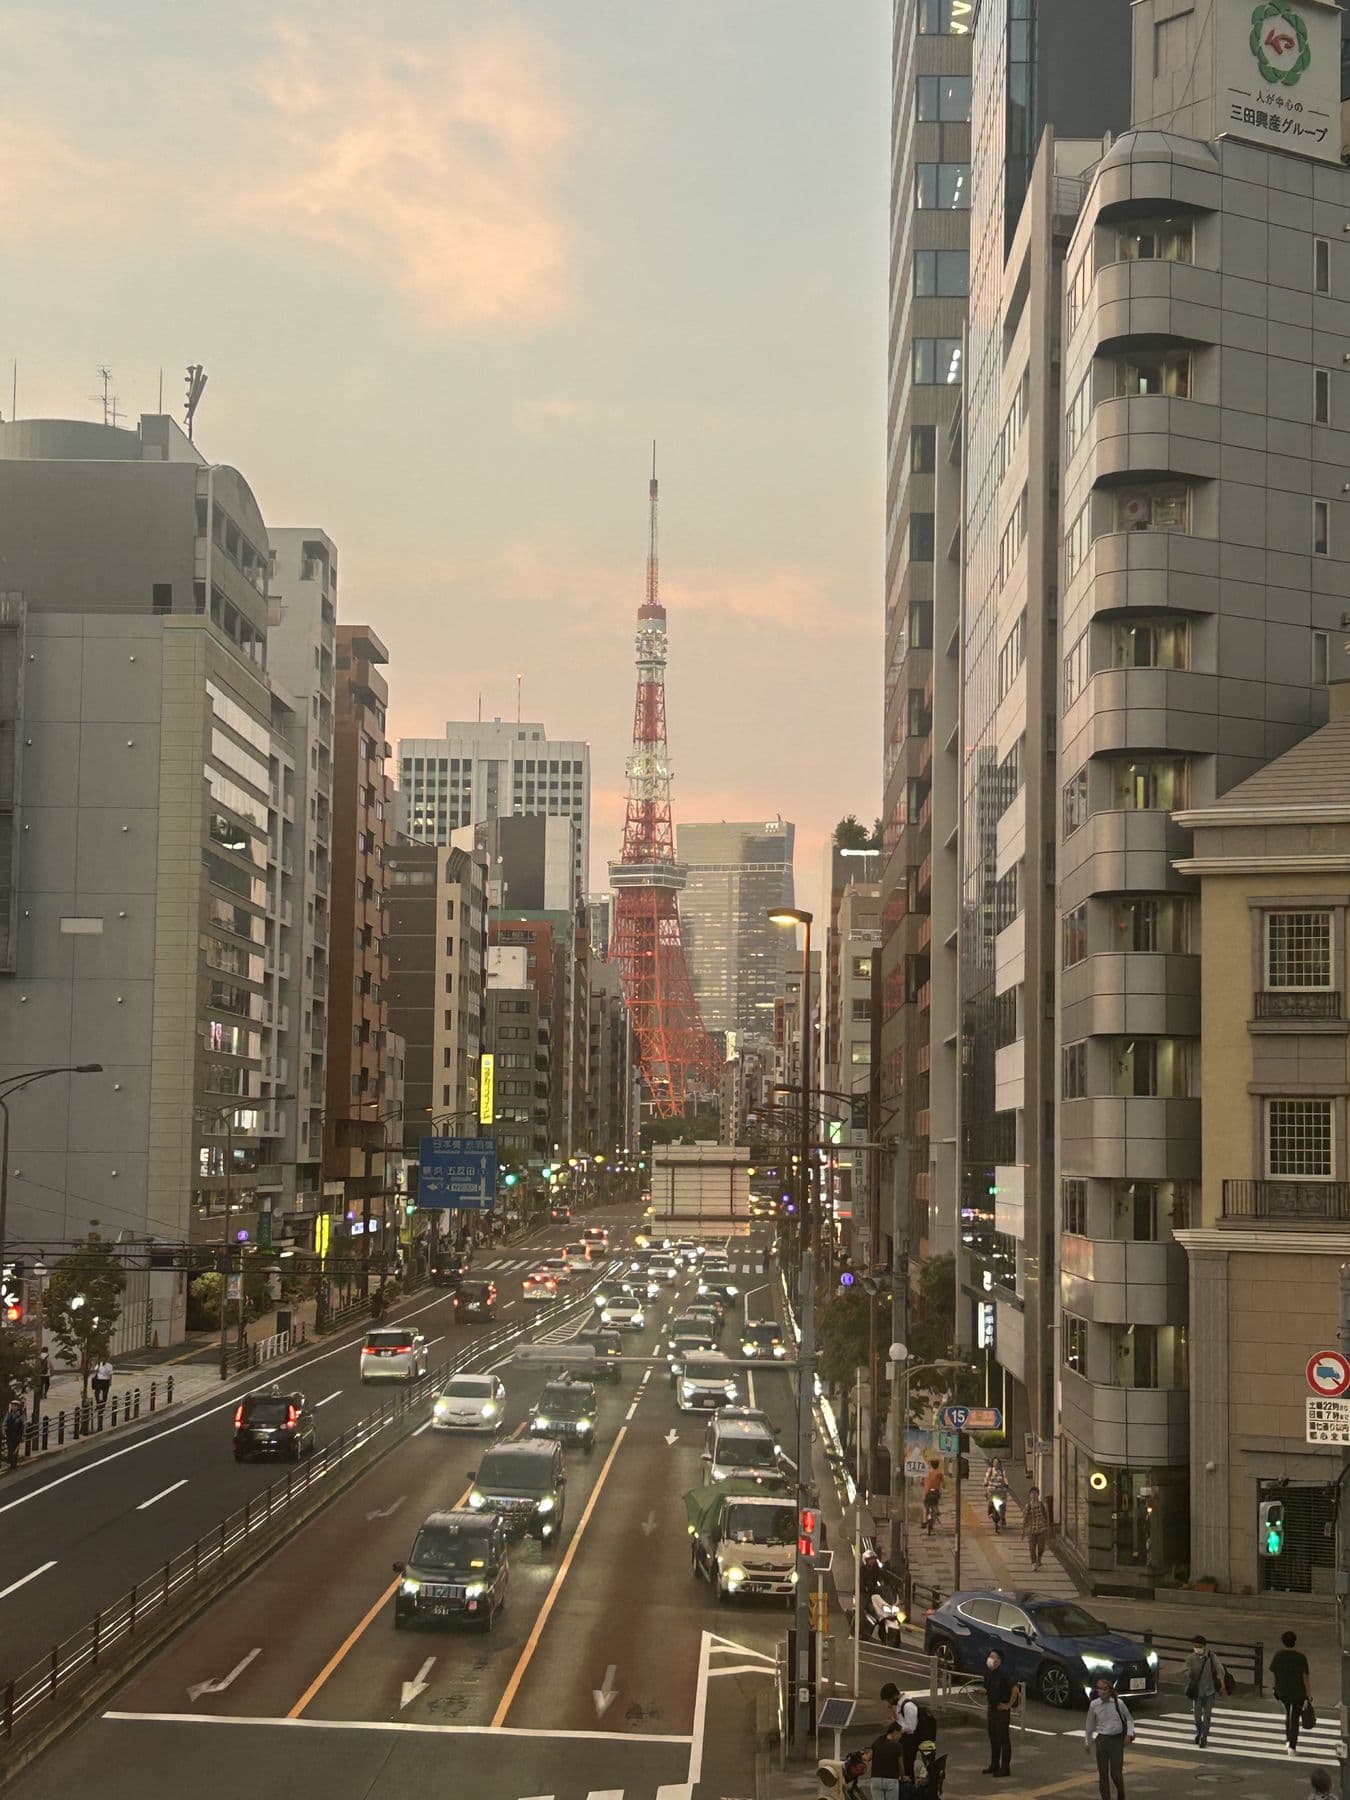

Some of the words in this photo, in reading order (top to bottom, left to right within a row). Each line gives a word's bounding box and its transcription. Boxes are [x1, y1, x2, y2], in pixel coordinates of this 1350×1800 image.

[1256, 90, 1304, 113] 人が中心の
[1230, 104, 1329, 143] 三田興産グループ
[447, 1166, 475, 1176] 五反田
[952, 1410, 965, 1423] 15
